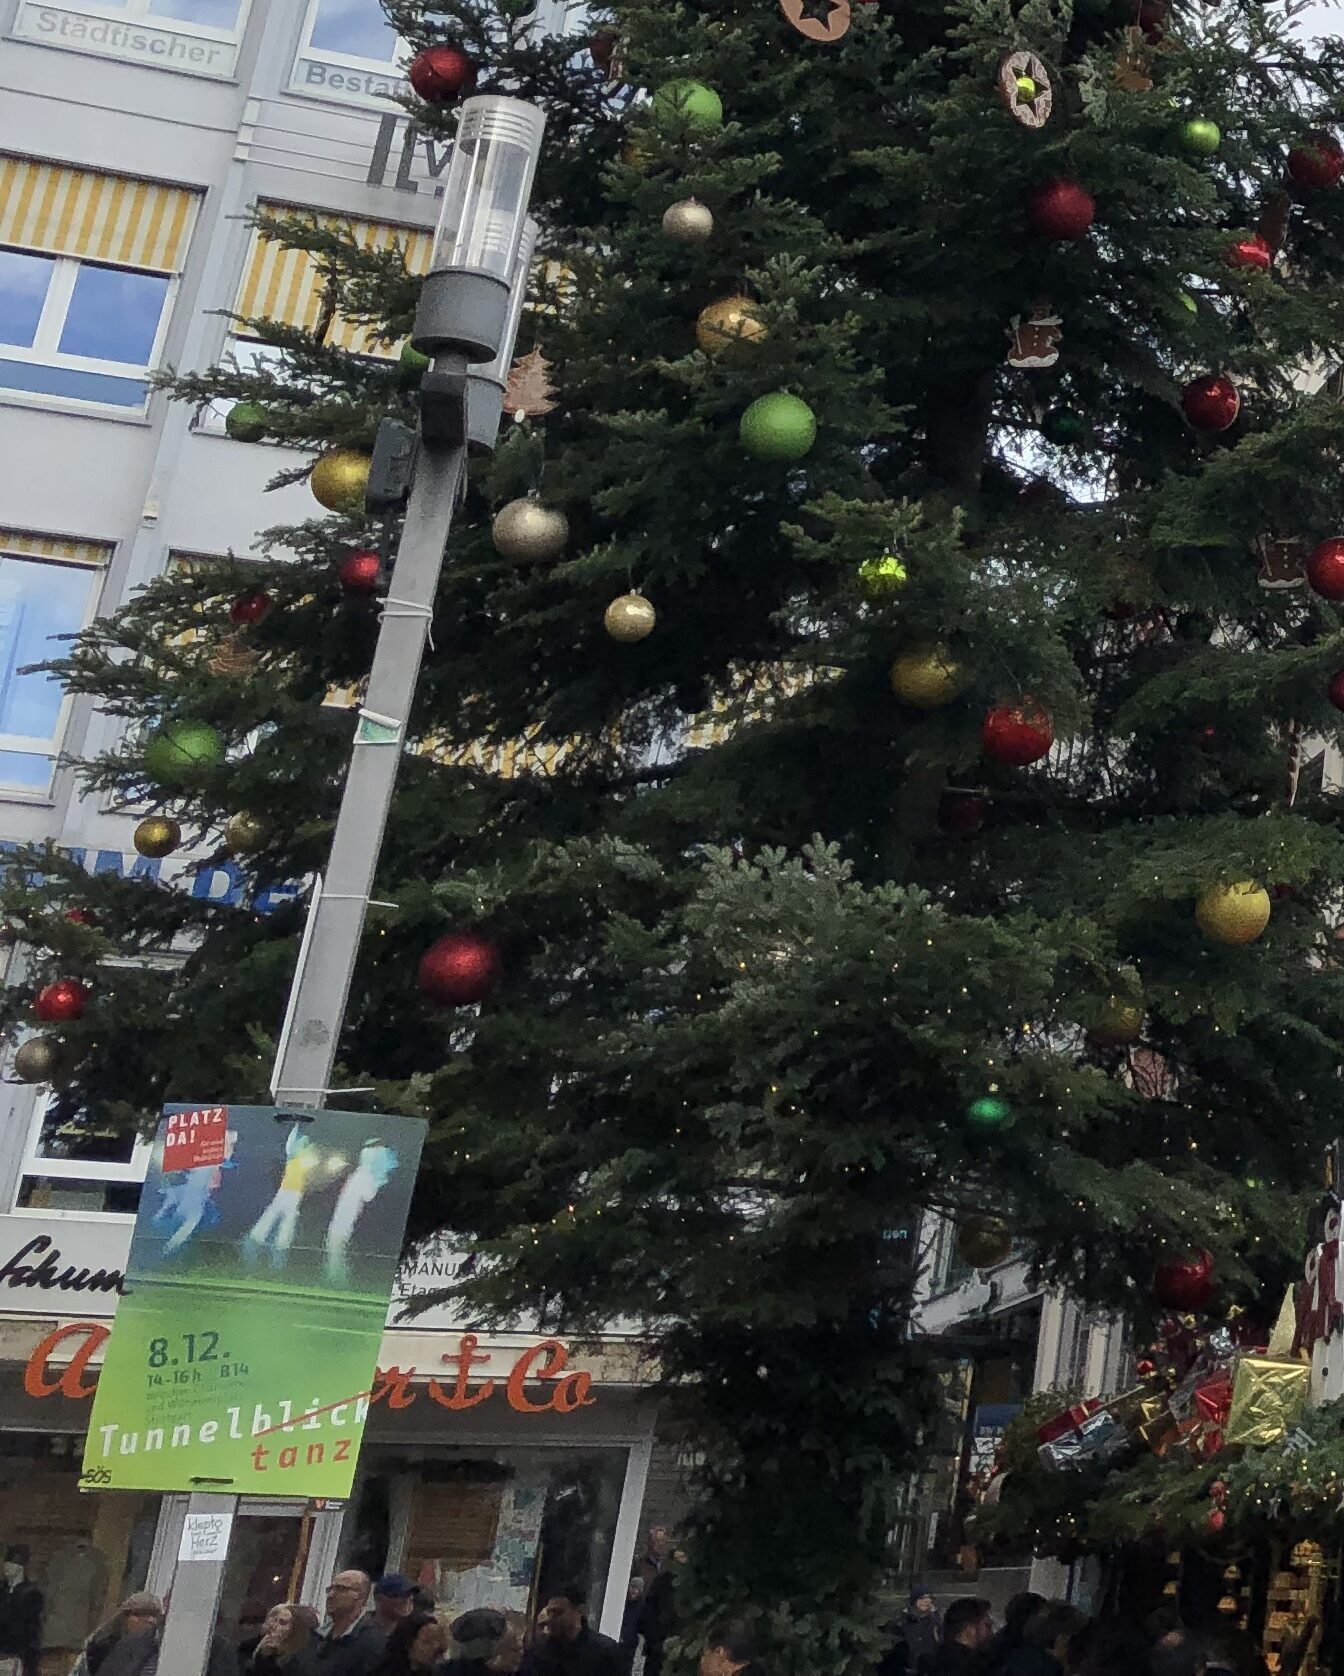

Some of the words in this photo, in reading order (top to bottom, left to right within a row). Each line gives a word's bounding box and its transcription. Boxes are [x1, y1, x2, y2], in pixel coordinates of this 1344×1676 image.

[36, 10, 220, 65] Städtischer
[305, 63, 409, 98] Bestat
[168, 1108, 223, 1129] PLATZ
[166, 1130, 196, 1147] DA!
[148, 1330, 230, 1368] 8.12.
[100, 1392, 369, 1457] Tunnelblick
[251, 1438, 352, 1471] tanz
